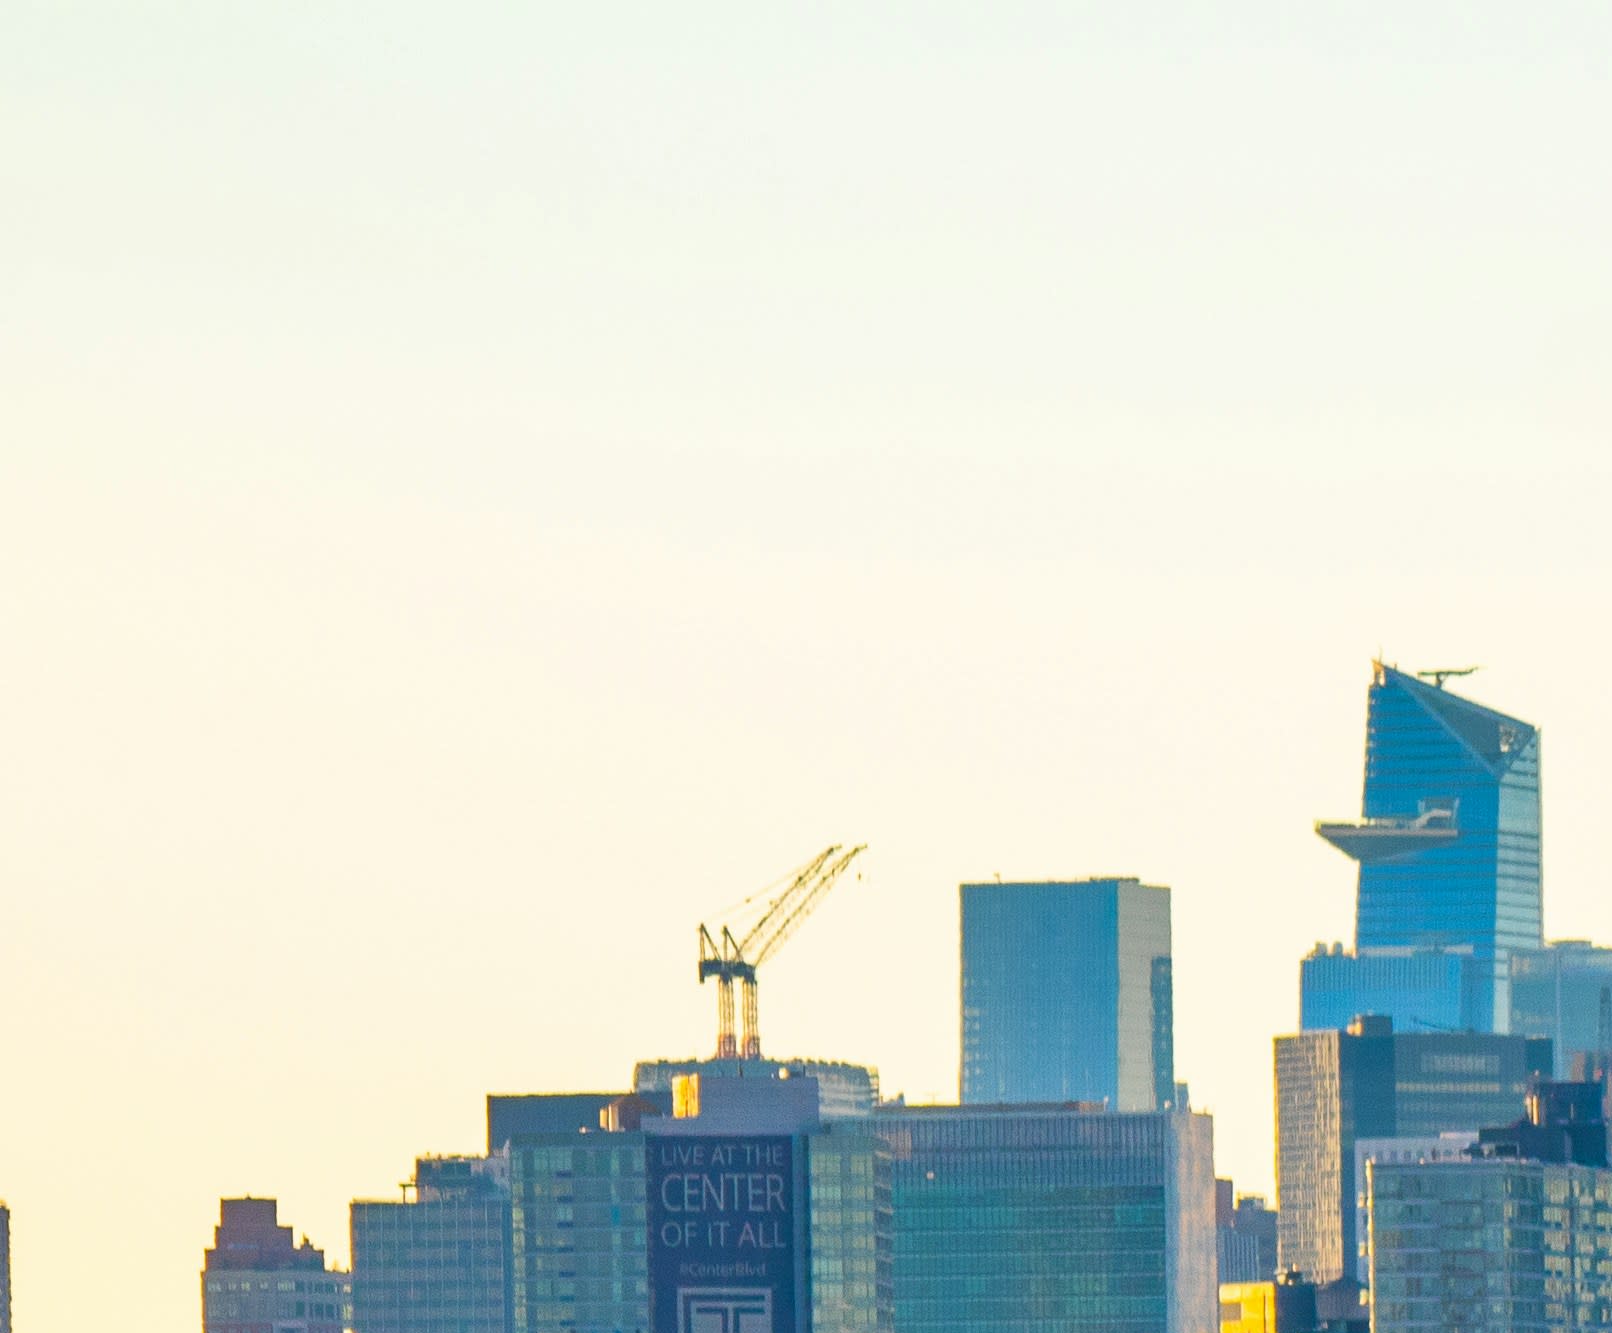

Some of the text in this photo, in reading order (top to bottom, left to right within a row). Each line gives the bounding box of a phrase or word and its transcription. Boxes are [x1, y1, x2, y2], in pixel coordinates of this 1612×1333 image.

[661, 1144, 783, 1166] LIVE AT THE
[661, 1173, 786, 1213] CENTER
[661, 1221, 786, 1249] OF IT ALL
